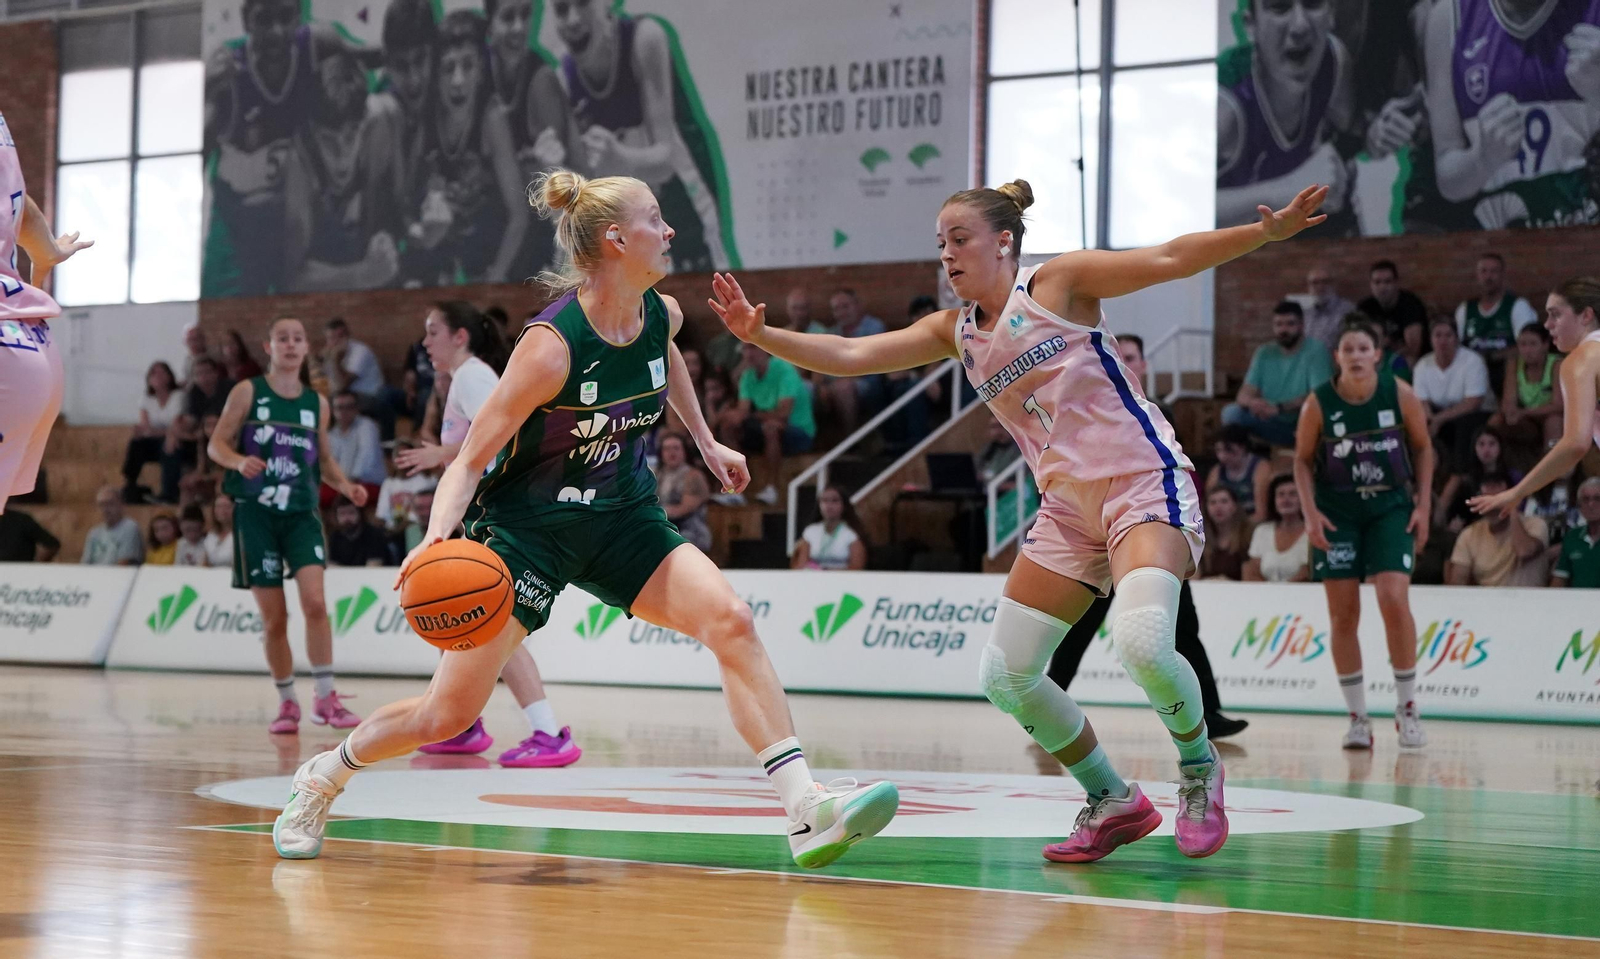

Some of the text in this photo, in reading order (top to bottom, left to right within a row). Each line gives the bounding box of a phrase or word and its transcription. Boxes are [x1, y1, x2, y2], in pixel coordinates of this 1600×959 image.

[746, 55, 945, 102] NUESTRA CANTERA
[747, 91, 943, 140] NUESTRO FUTURO
[258, 484, 291, 511] 24
[414, 604, 487, 632] Wilson
[862, 623, 967, 657] Unicaja
[1231, 613, 1327, 671] Mijas
[1369, 682, 1480, 697] AYUAMIENTO
